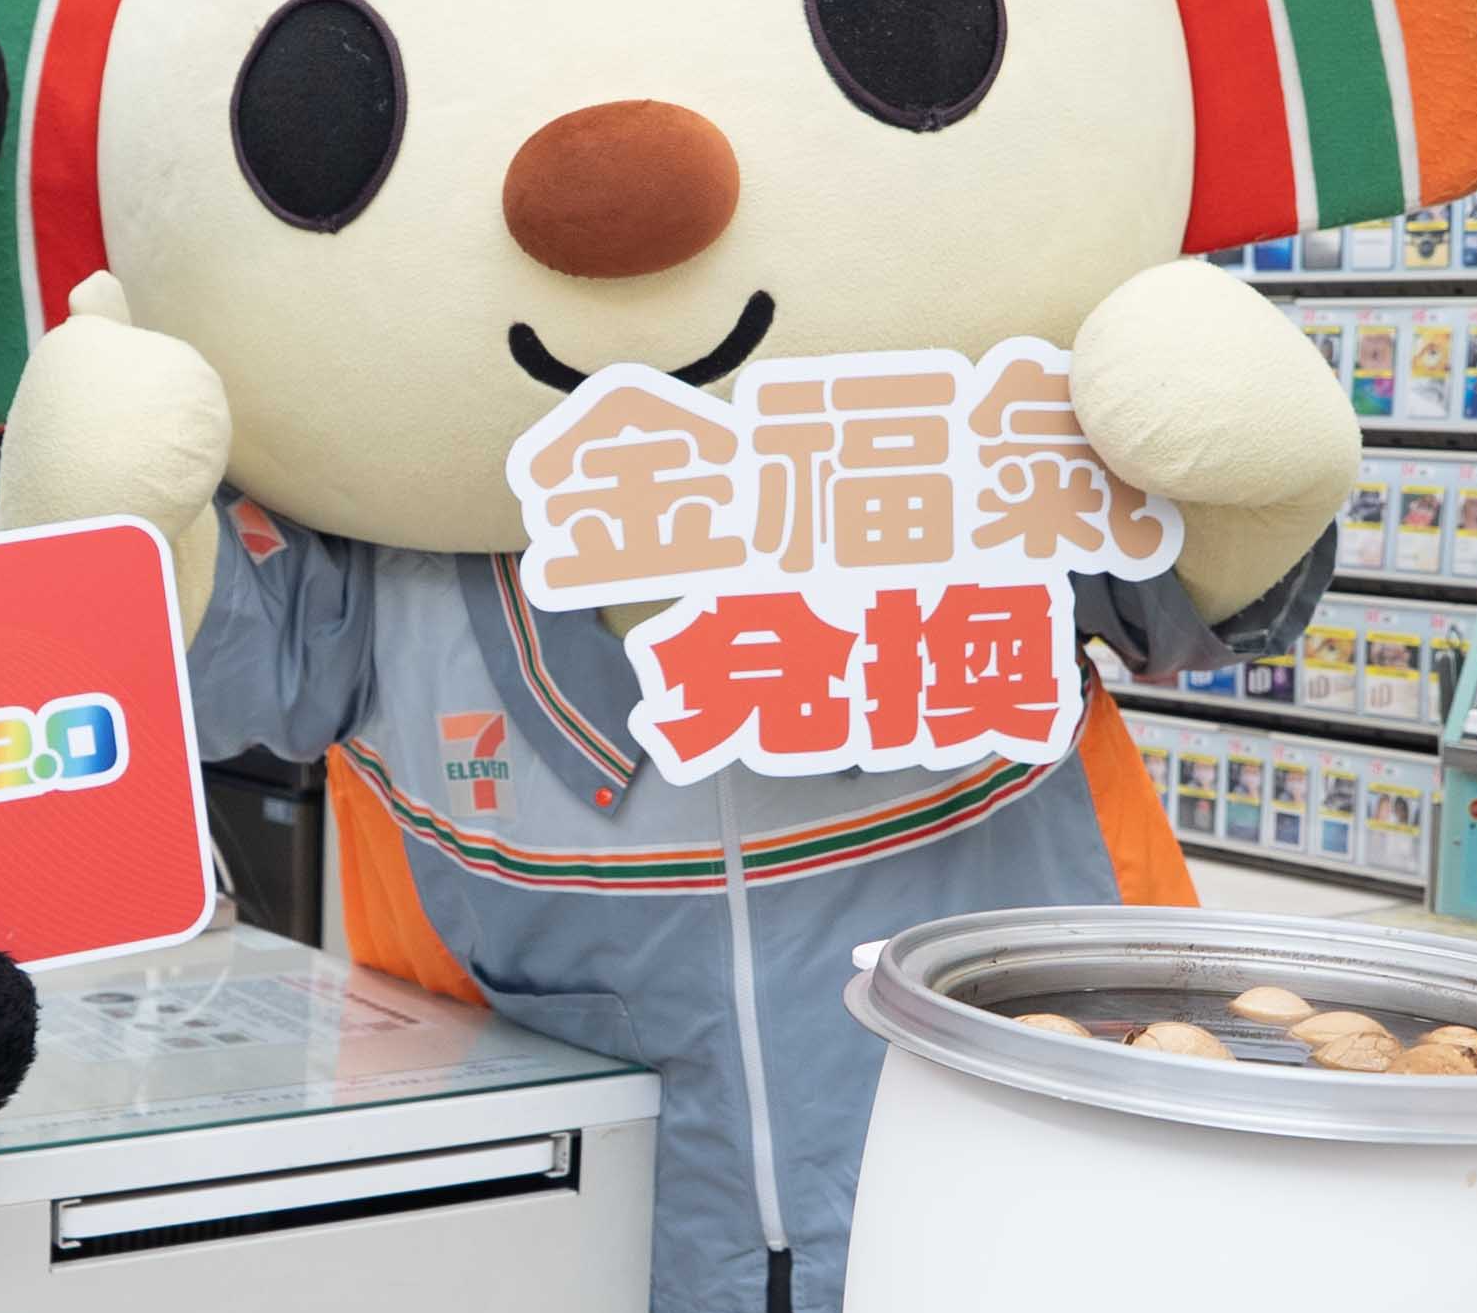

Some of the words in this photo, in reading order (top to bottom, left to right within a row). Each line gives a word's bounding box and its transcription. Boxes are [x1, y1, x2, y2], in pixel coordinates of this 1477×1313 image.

[530, 359, 1167, 591] 金福氣
[650, 582, 1061, 763] 兌換
